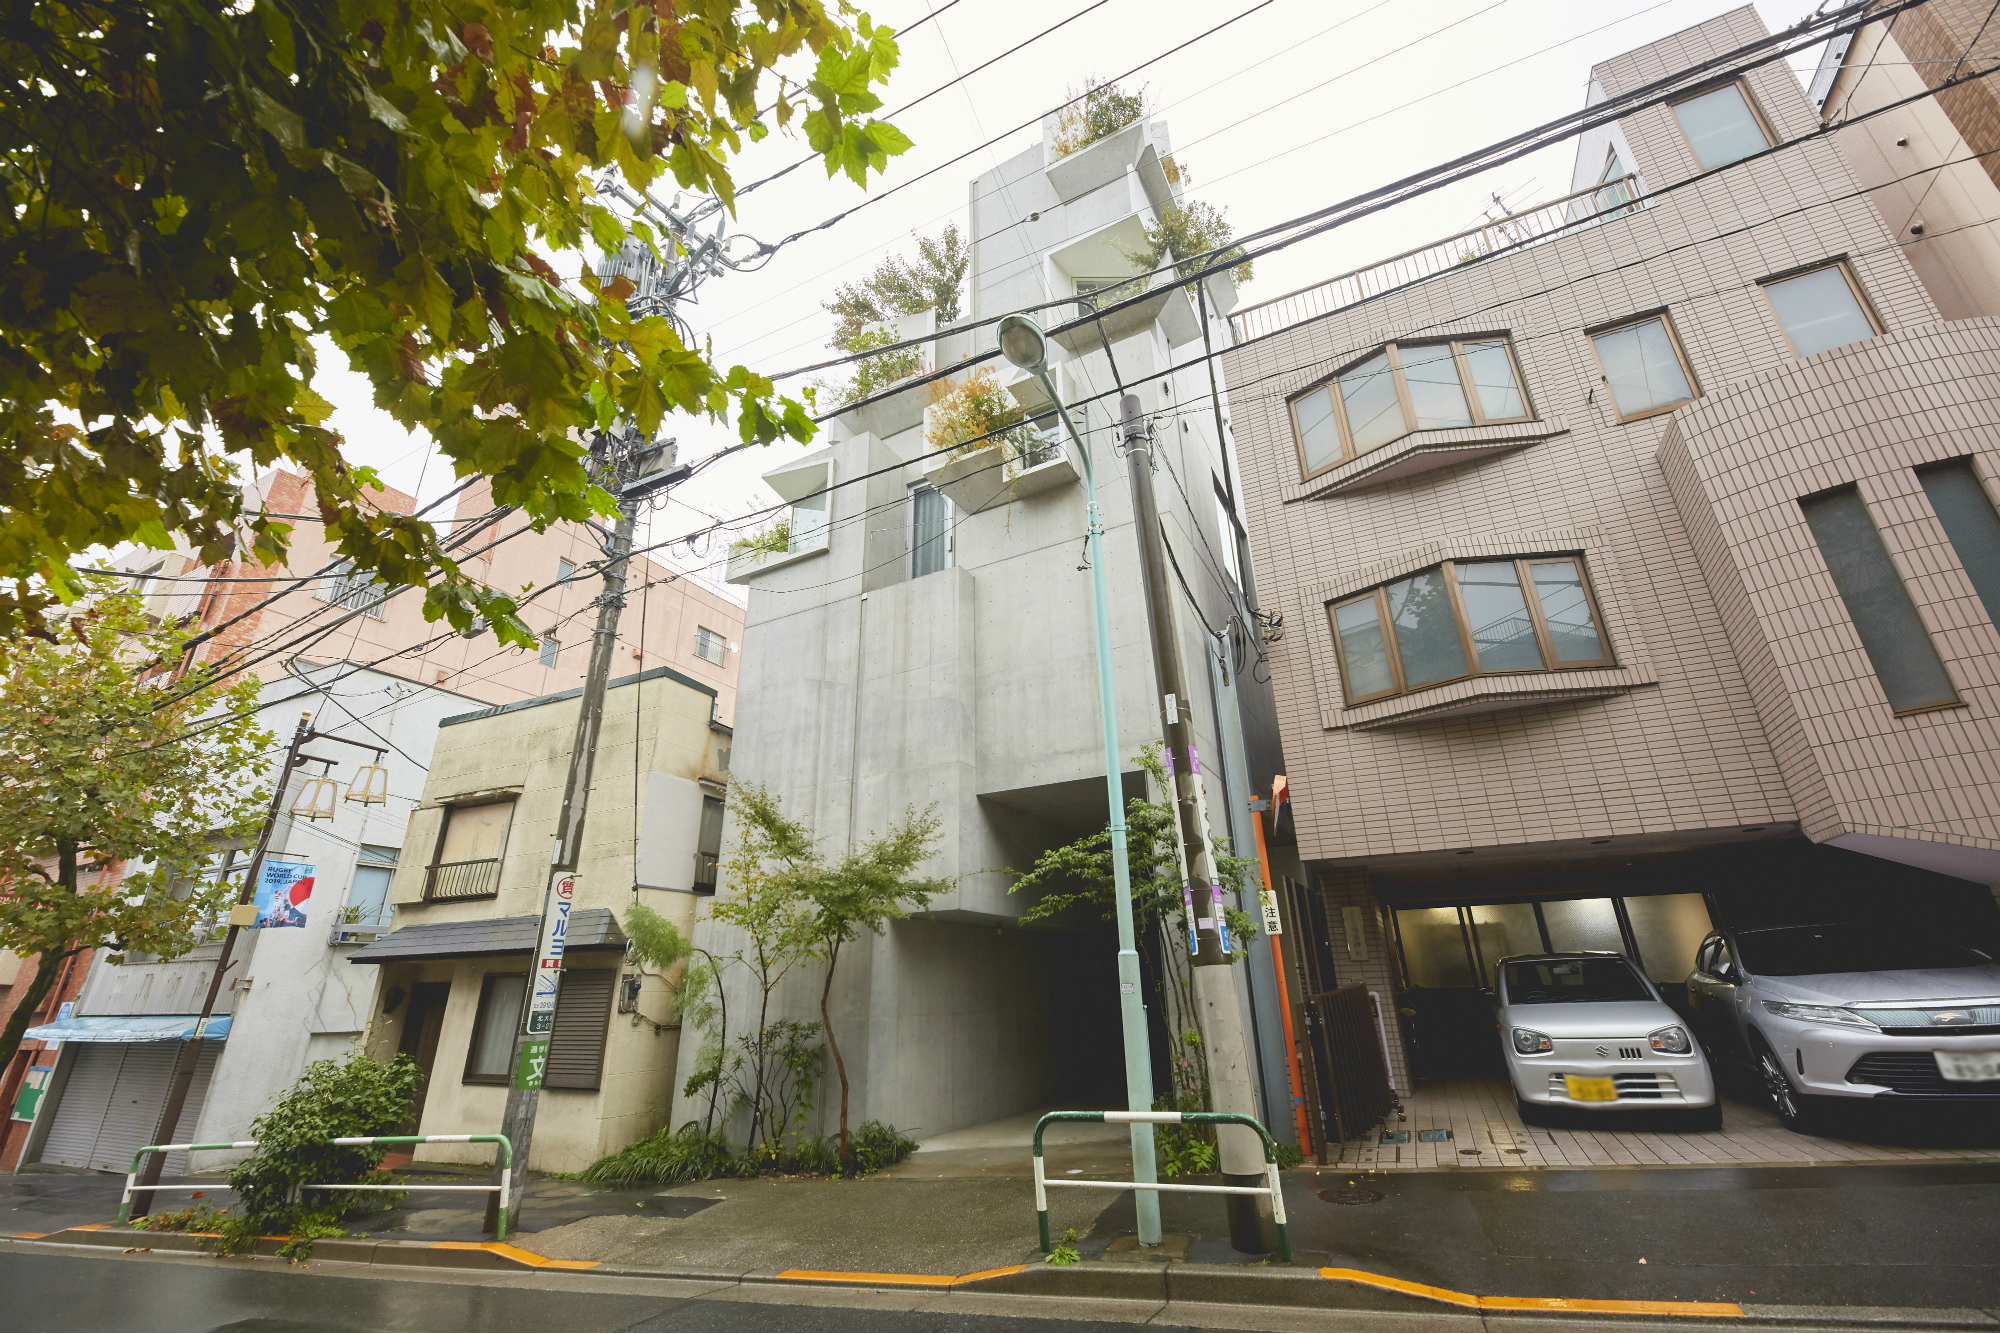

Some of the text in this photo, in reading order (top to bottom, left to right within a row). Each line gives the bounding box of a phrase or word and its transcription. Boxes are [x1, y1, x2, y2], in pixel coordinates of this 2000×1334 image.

[561, 880, 575, 895] 質
[550, 901, 571, 955] マルヨ
[1265, 906, 1279, 932] 注意
